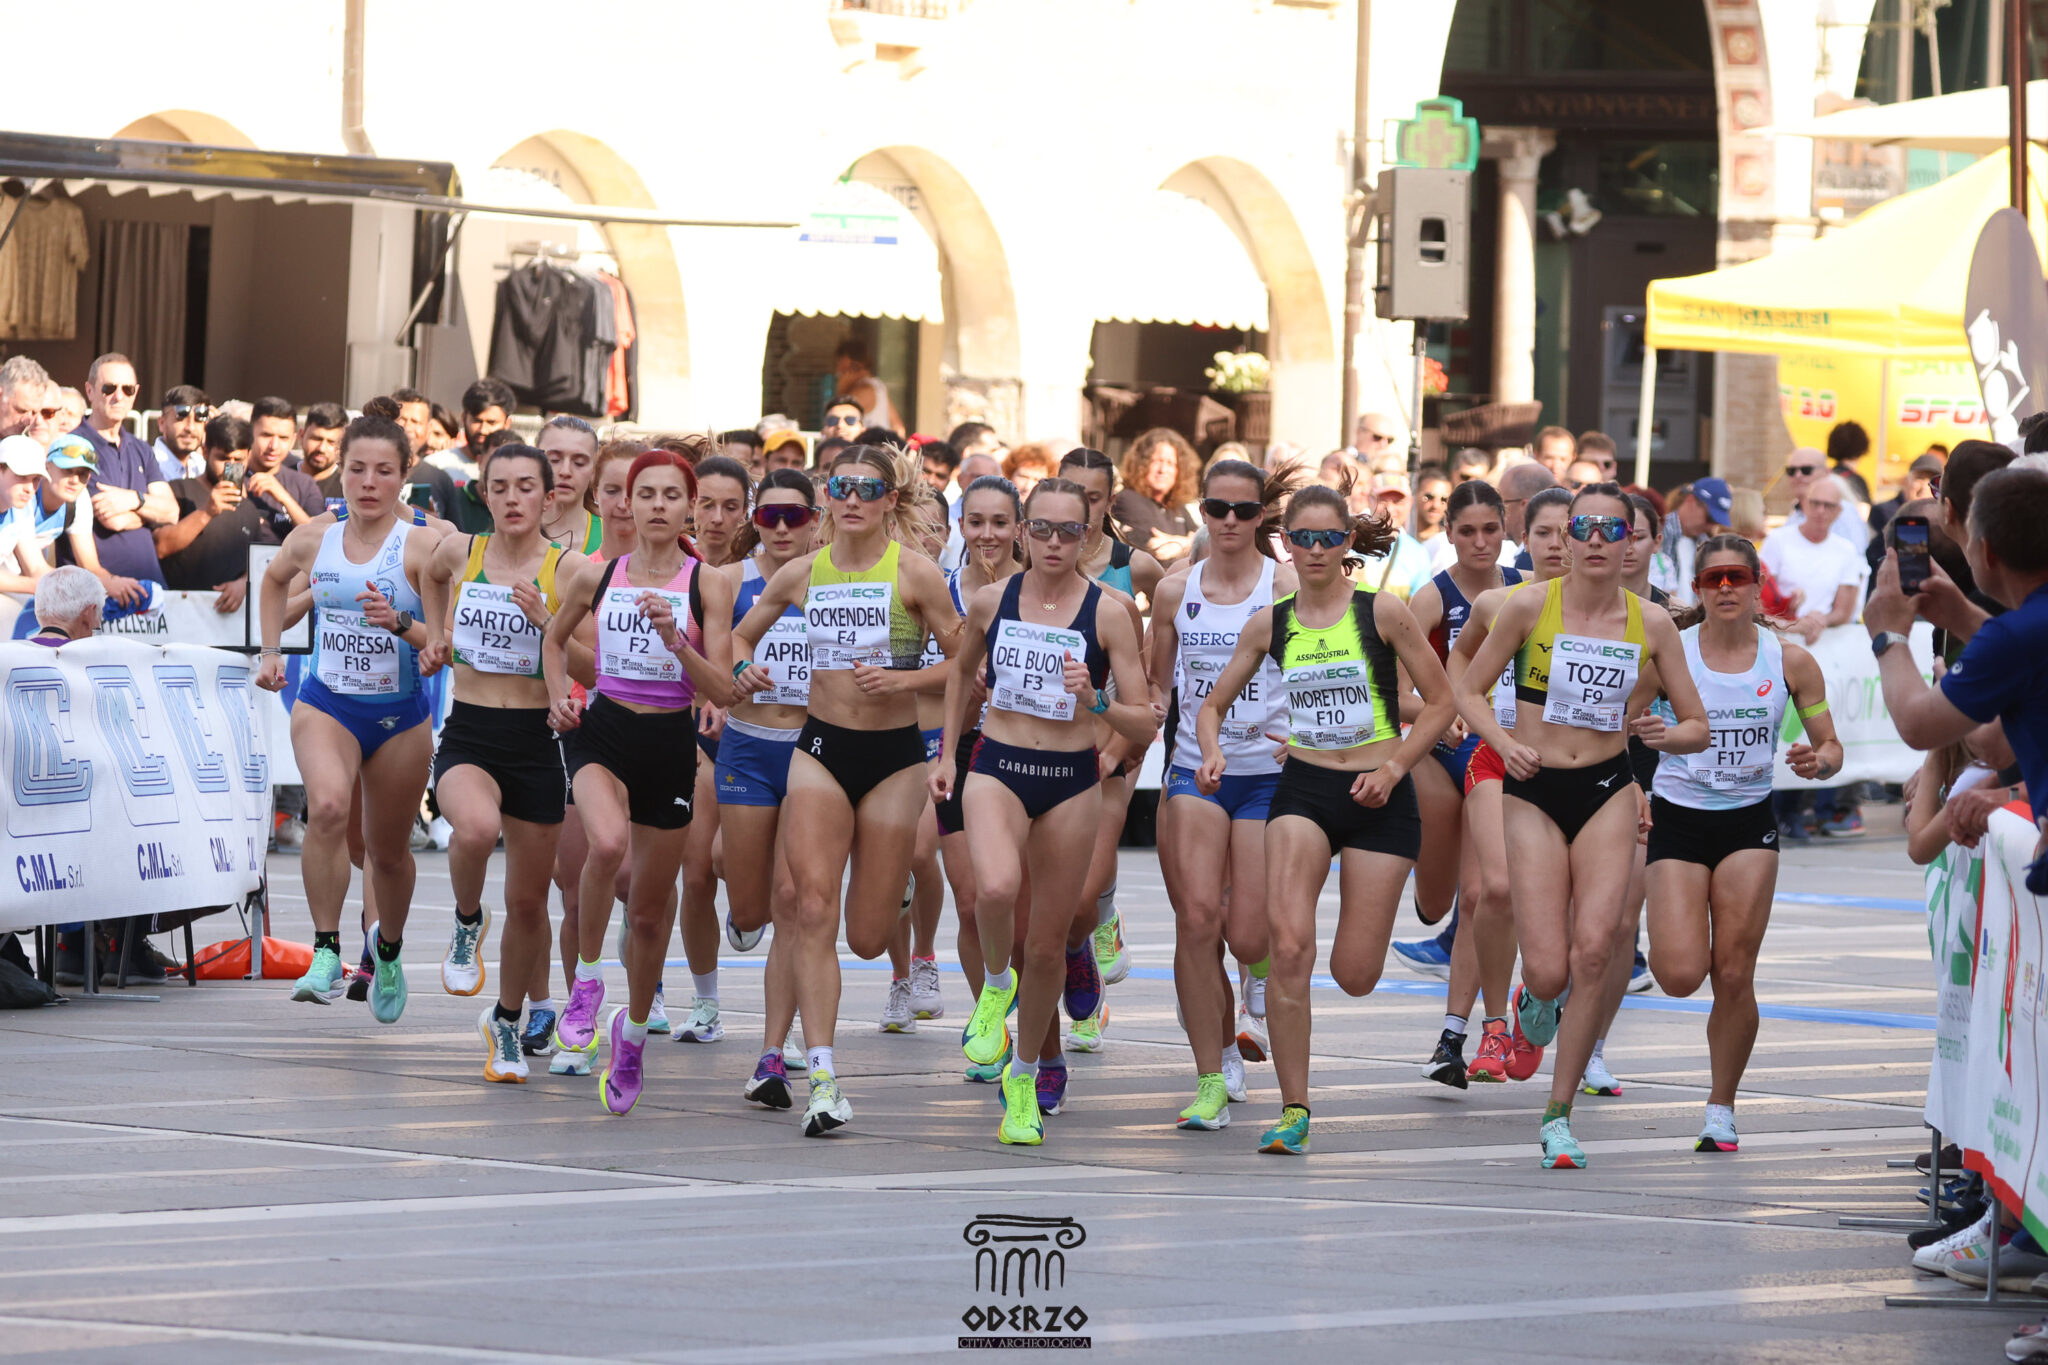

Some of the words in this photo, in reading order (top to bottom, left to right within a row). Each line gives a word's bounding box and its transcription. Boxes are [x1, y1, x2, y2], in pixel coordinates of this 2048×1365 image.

[815, 587, 885, 601] COMECS
[607, 611, 677, 635] LUKA
[809, 607, 886, 627] OCKENDEN
[322, 632, 395, 654] MORESSA
[481, 632, 511, 649] F22
[629, 637, 649, 654] F2
[837, 630, 857, 645] F4
[1005, 626, 1080, 648] COMECS
[996, 646, 1021, 669] DEL
[1295, 649, 1350, 662] ASSINDUSTRIA
[1560, 640, 1635, 660] COMECS
[344, 656, 371, 671] F18
[788, 665, 808, 681] F6
[1023, 673, 1043, 691] F3
[1288, 666, 1360, 683] COMECS
[1566, 662, 1625, 689] TOZZI
[1289, 684, 1368, 710] MORETTON
[1582, 688, 1603, 705] F9
[1316, 709, 1345, 726] F10
[999, 758, 1074, 777] CARABINIERI
[1717, 751, 1746, 766] F17
[137, 842, 172, 881] C.M.L.
[16, 853, 66, 893] C.M.L.
